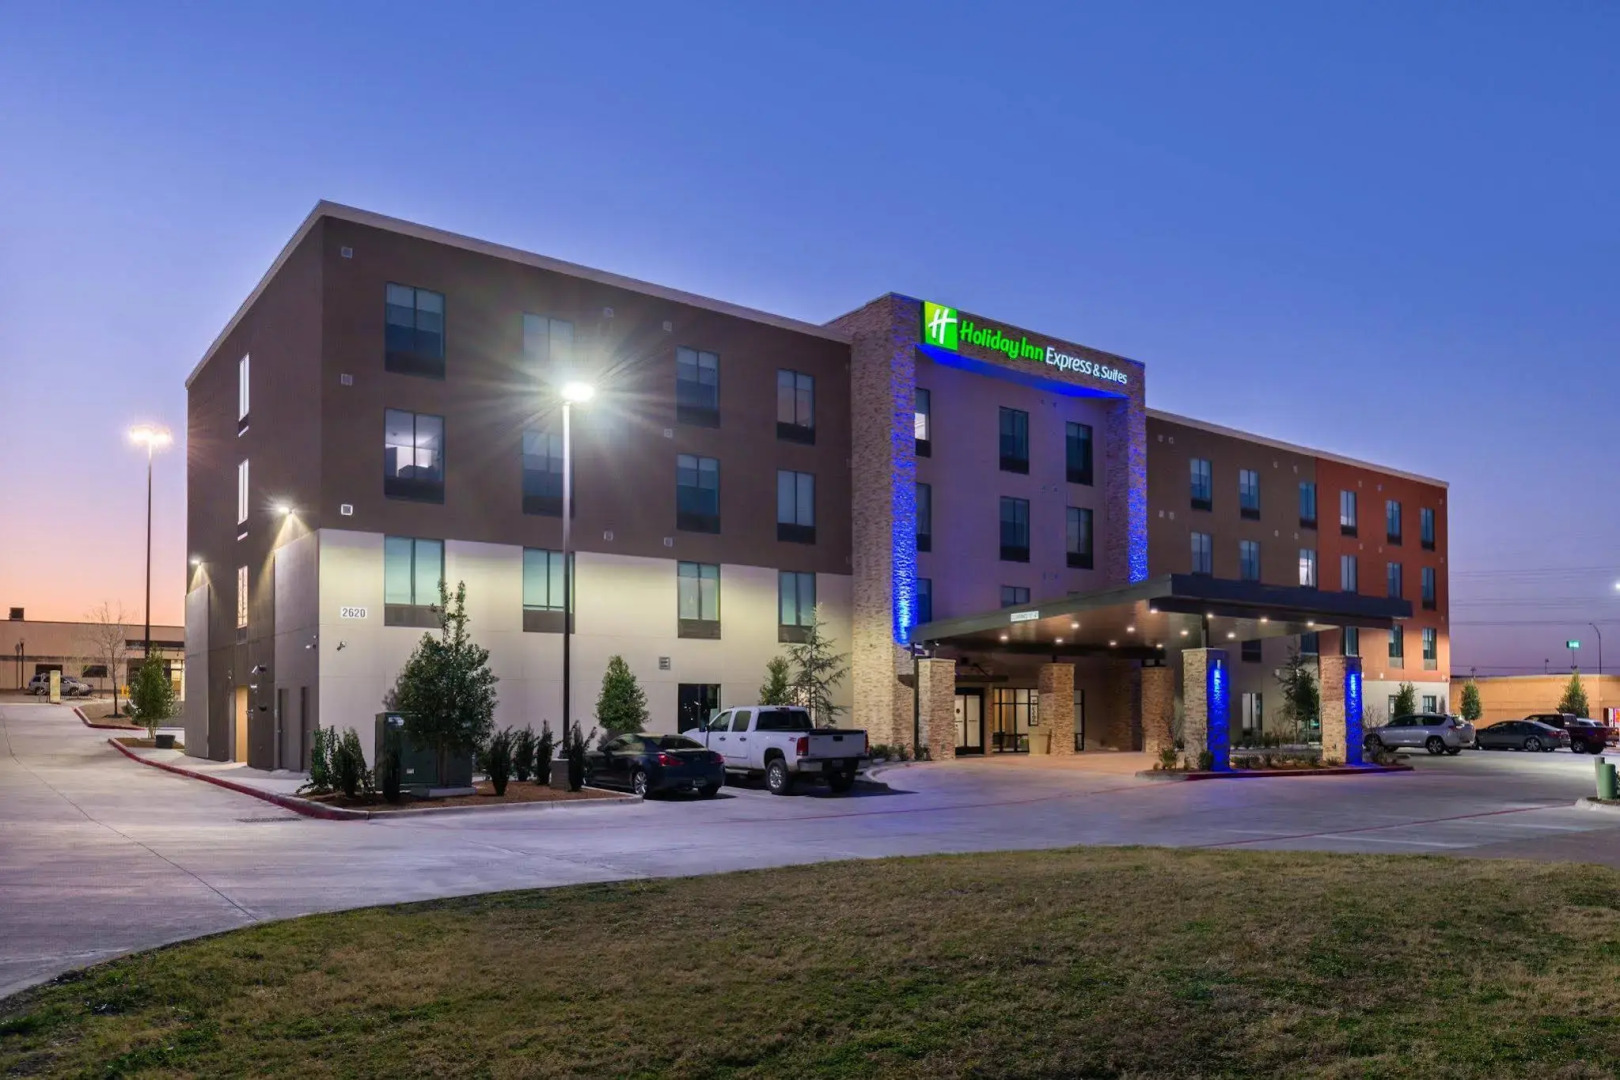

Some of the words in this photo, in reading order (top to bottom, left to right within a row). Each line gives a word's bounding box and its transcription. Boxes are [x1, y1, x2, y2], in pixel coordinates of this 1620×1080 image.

[960, 320, 1019, 359] Holiday
[1021, 336, 1044, 362] Inn
[1045, 346, 1092, 375] Express
[1092, 364, 1101, 377] &
[1101, 366, 1127, 385] Suites
[342, 607, 366, 618] 2620
